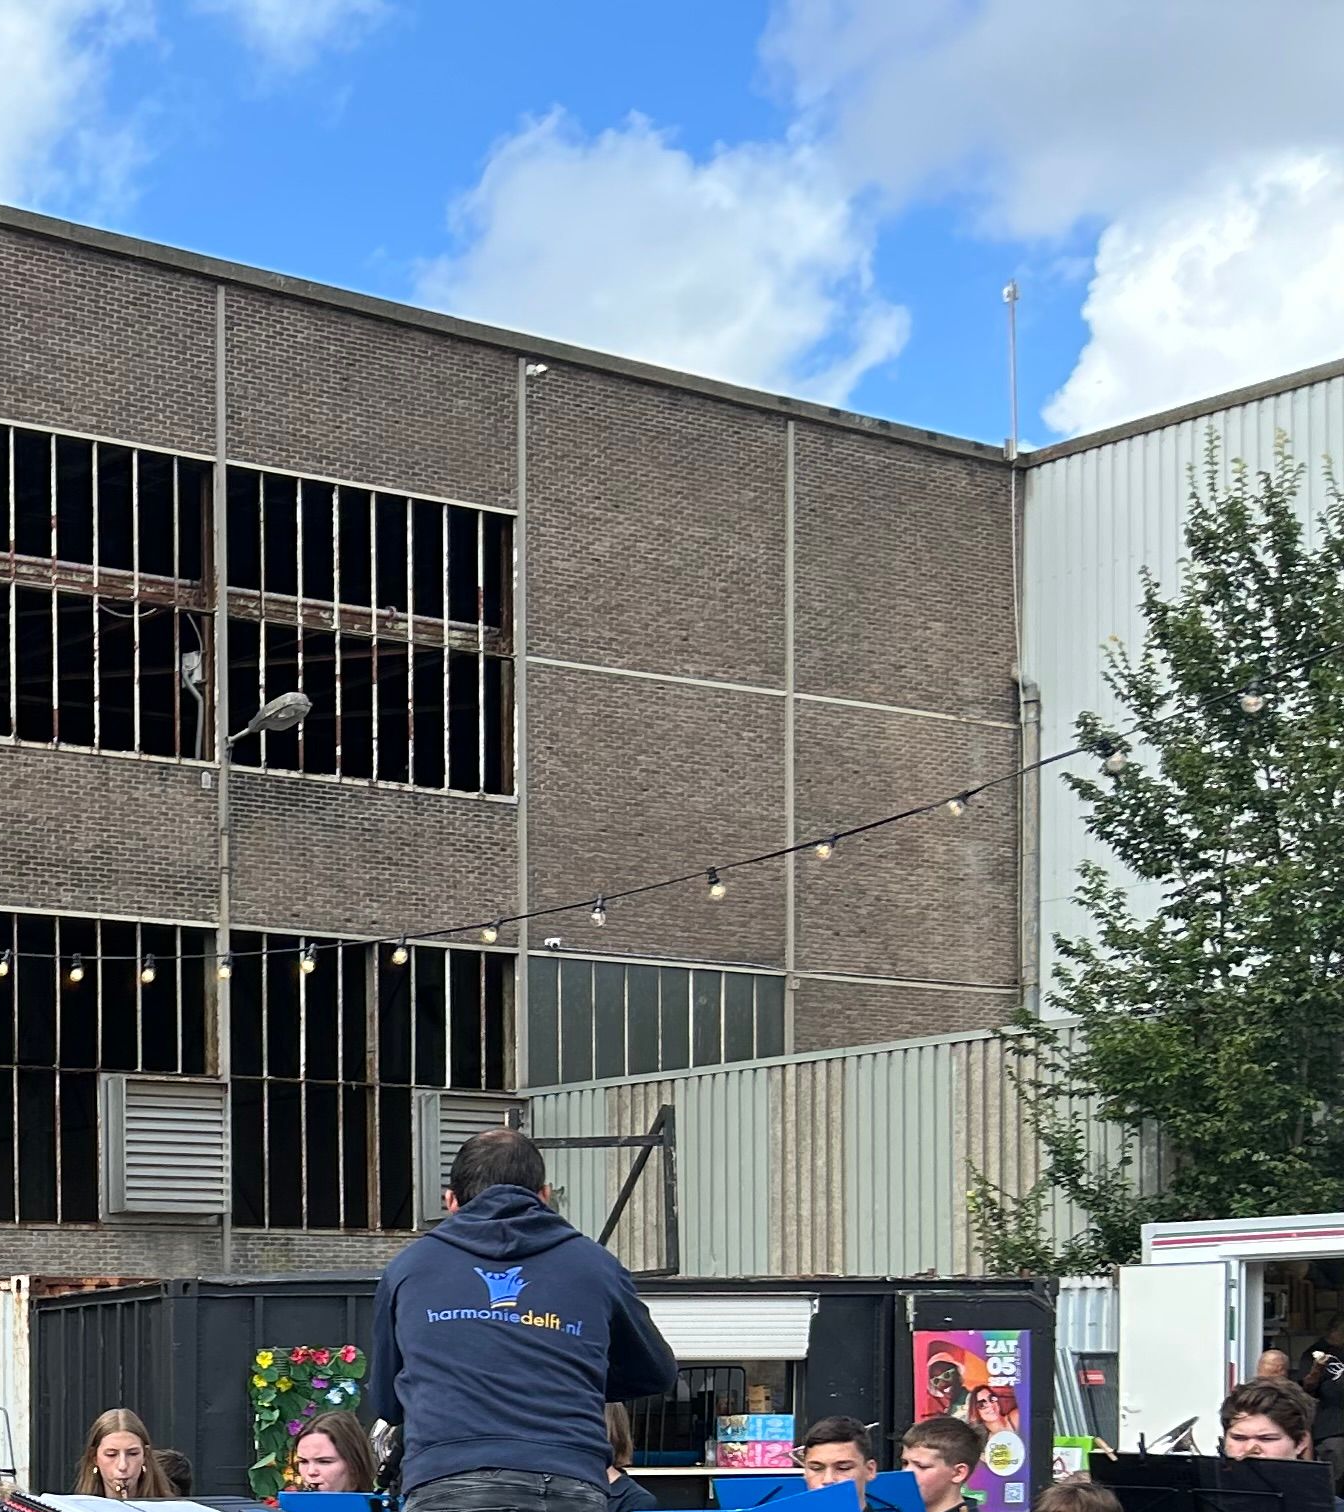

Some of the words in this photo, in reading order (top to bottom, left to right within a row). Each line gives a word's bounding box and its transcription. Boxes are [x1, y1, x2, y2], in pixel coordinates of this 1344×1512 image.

[426, 1307, 583, 1337] harmoniedelft.nl
[985, 1339, 1018, 1354] ZAT
[986, 1356, 1017, 1376] 05
